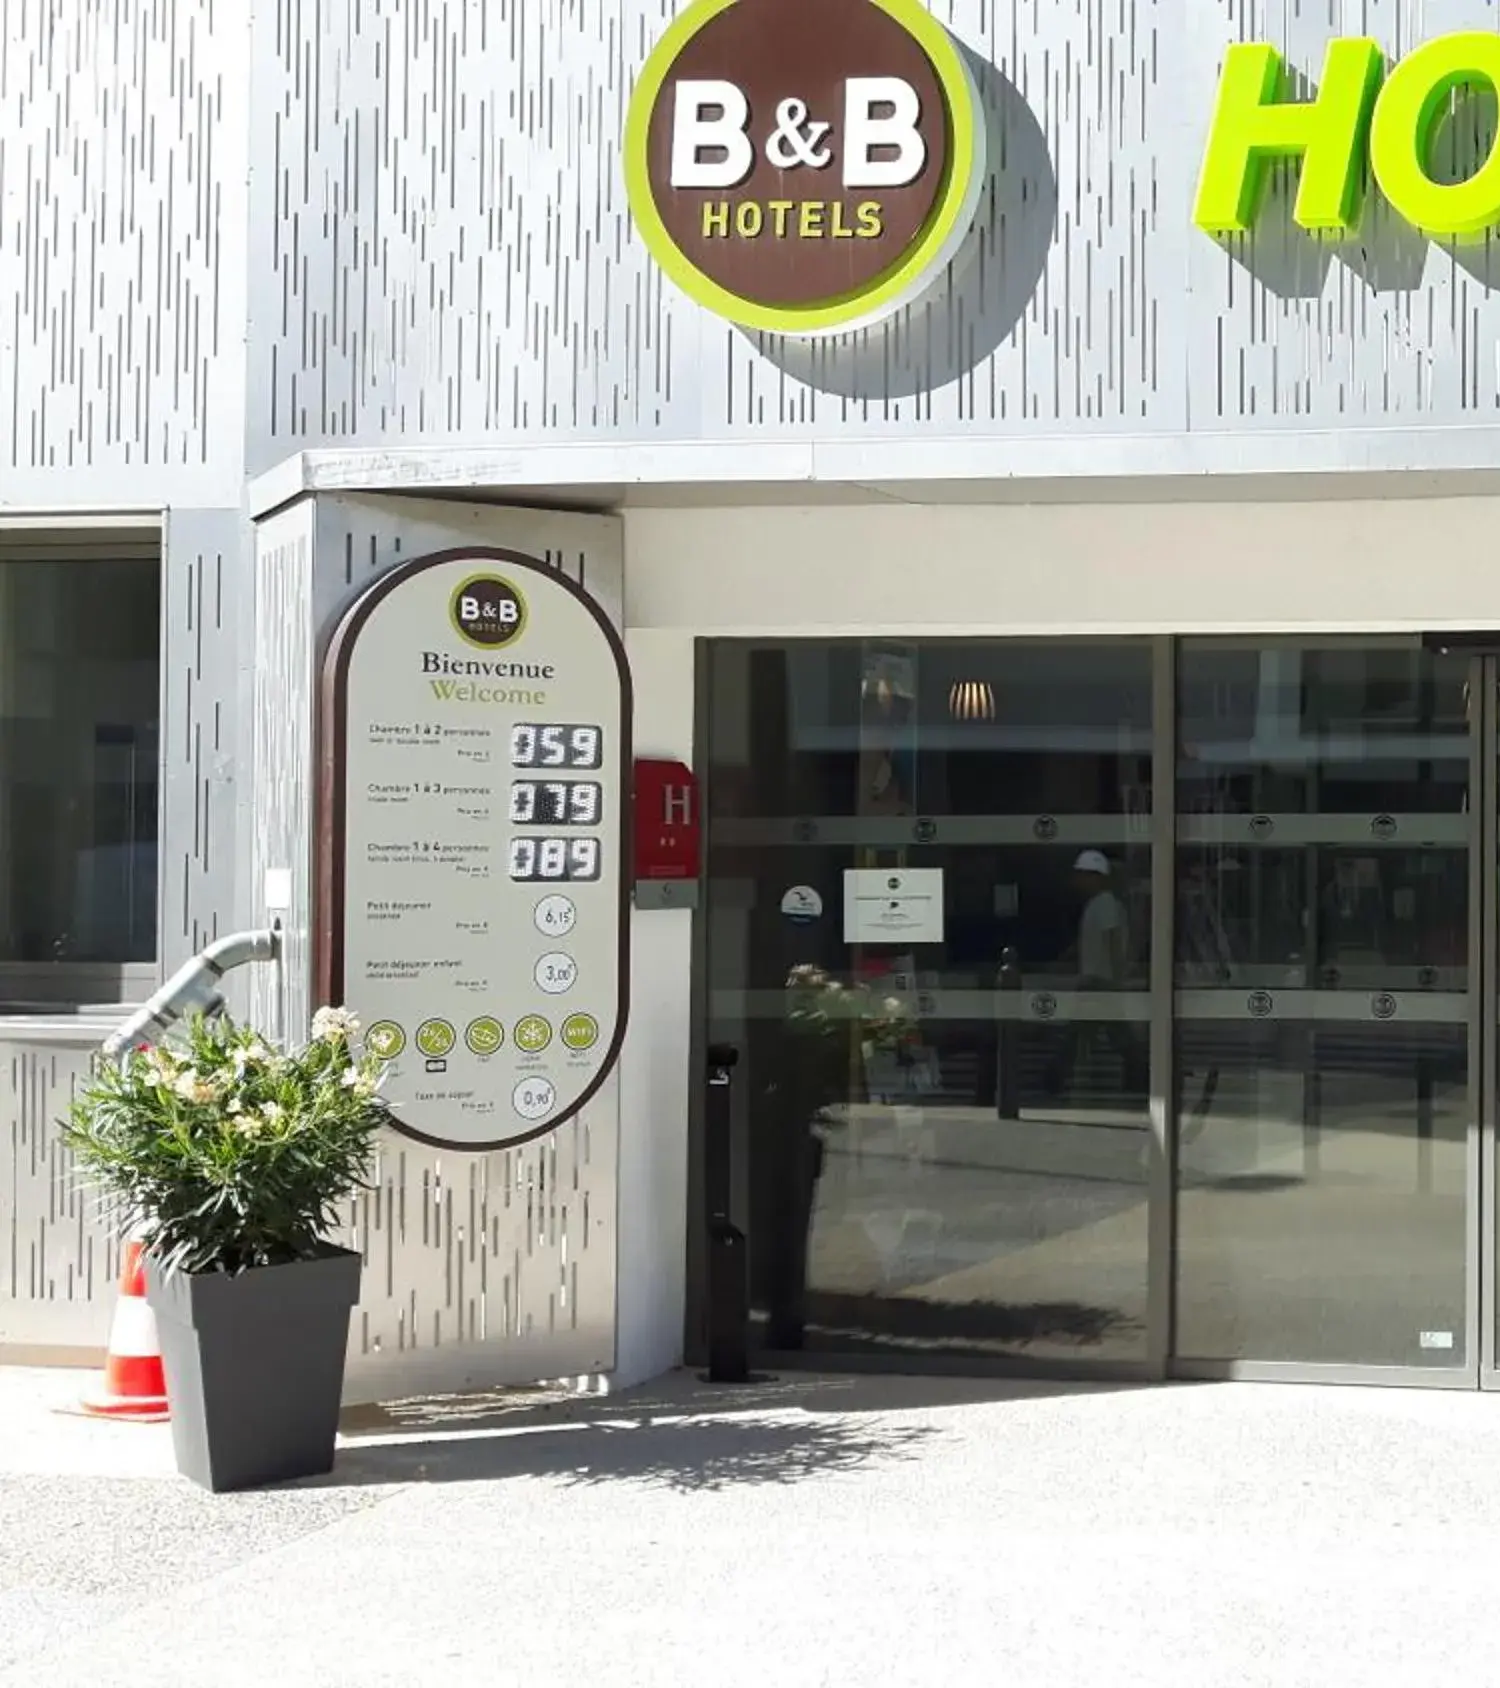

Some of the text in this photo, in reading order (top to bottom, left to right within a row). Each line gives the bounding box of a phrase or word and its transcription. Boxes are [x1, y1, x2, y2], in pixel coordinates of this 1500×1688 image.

[671, 77, 925, 188] B&B
[703, 201, 883, 238] HOTELS
[461, 596, 518, 622] B&B
[422, 652, 556, 680] Bienvenue
[430, 679, 547, 705] Welcome
[511, 725, 597, 765] 059
[510, 783, 597, 821] 079
[664, 783, 692, 826] H
[509, 838, 597, 876] 089
